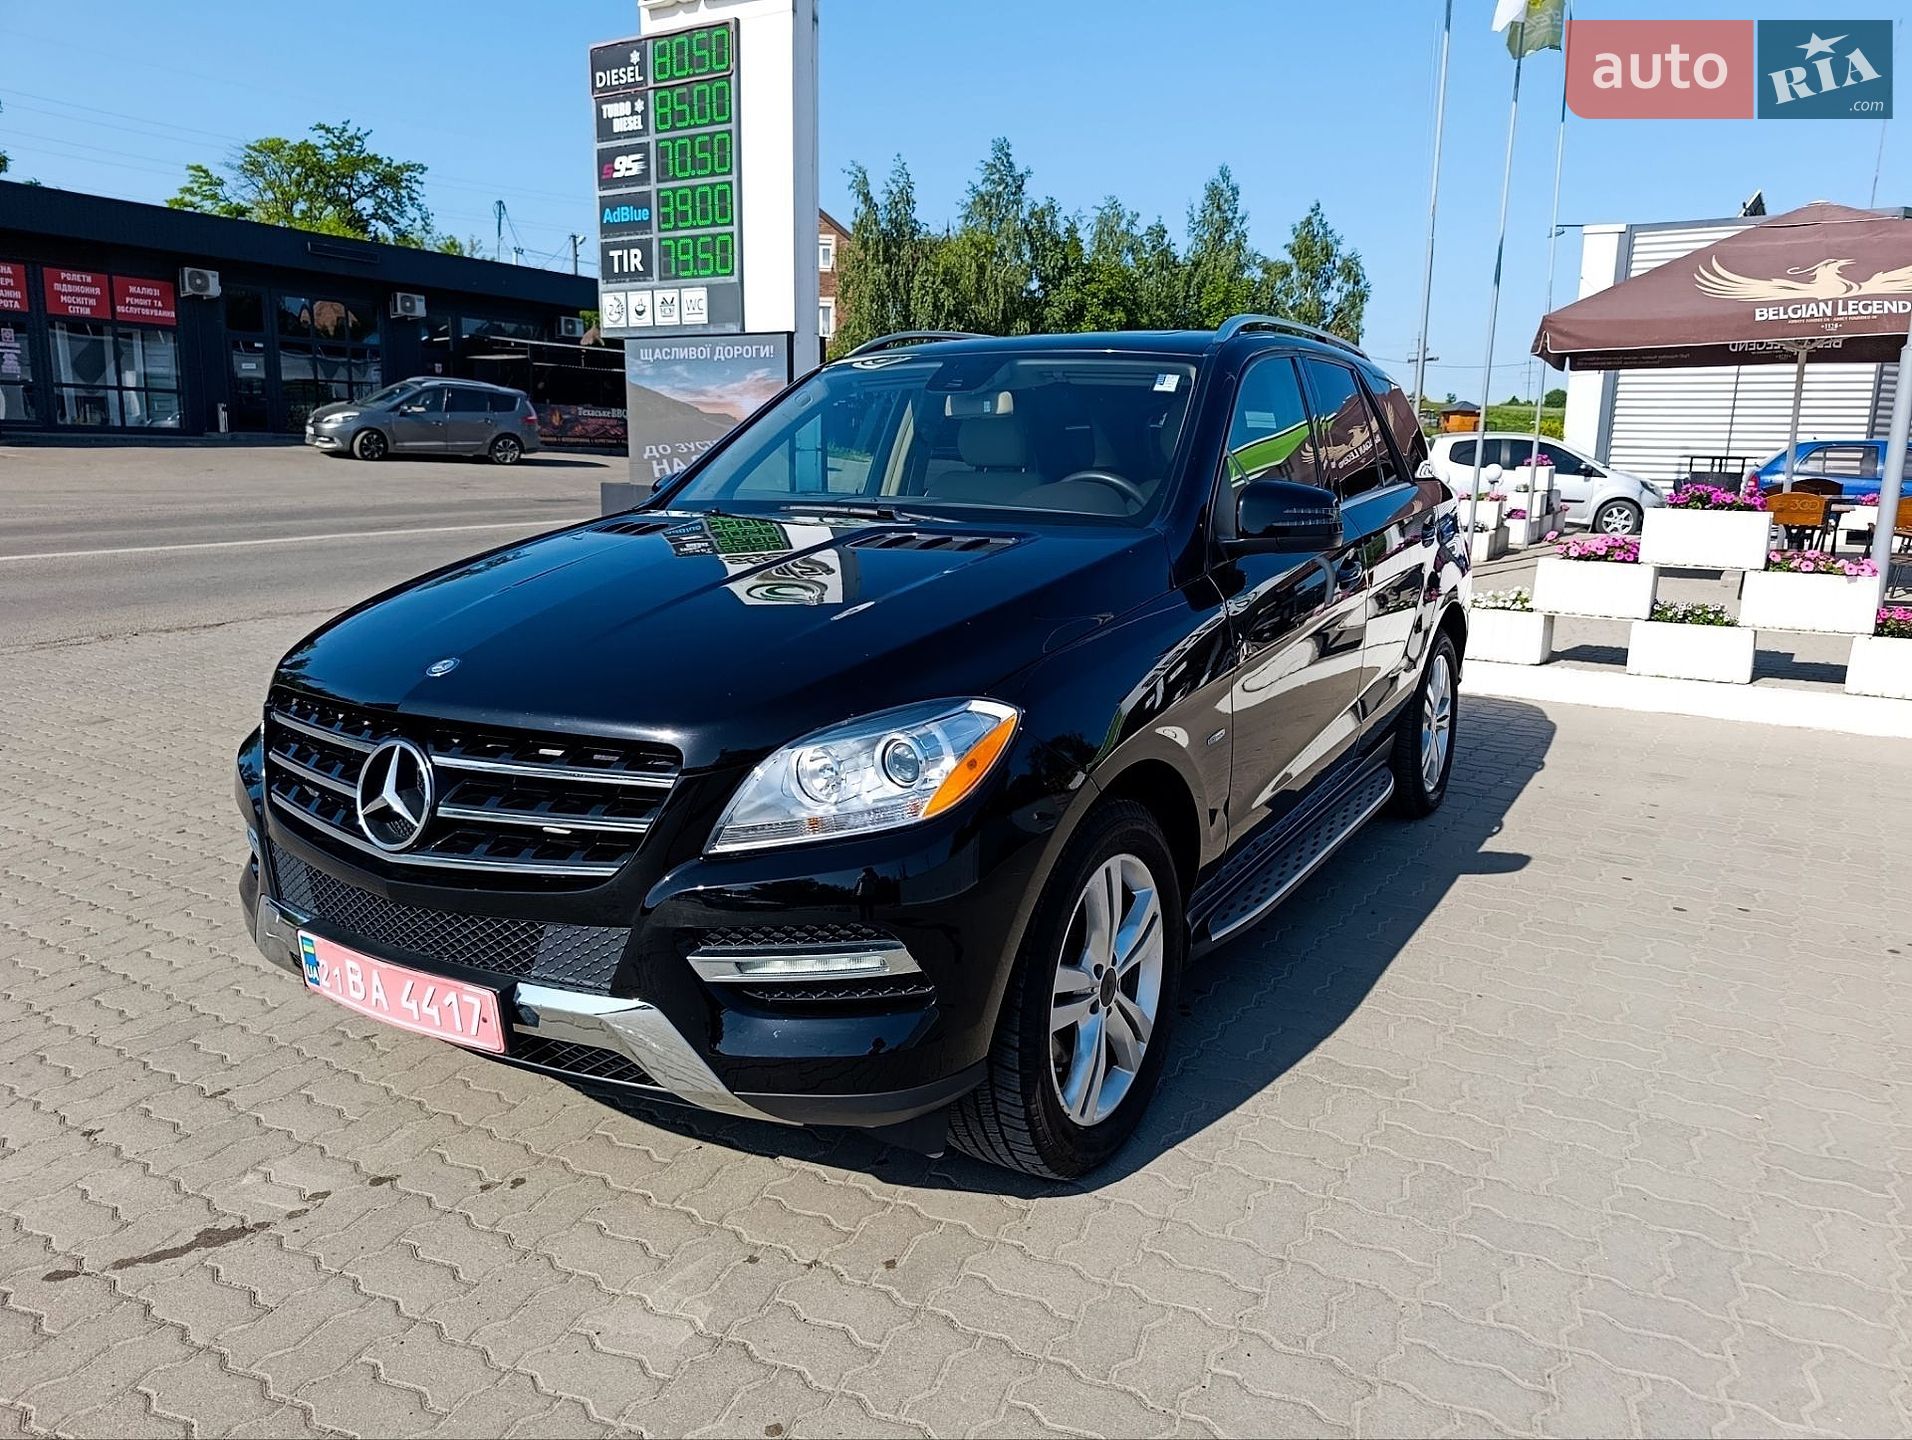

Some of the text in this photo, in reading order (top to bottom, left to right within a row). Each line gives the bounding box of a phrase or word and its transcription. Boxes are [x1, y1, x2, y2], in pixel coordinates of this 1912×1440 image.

[655, 27, 729, 81] 80.50
[596, 65, 643, 88] DIESEL
[656, 81, 730, 131] 85.00
[612, 115, 643, 133] DIESEL
[659, 132, 731, 178] 70.50
[603, 206, 650, 224] AdBlue
[659, 183, 732, 230] 39.00
[609, 248, 644, 274] TIR
[661, 234, 733, 278] 79.50
[60, 272, 92, 283] РОЛЕТИ
[53, 282, 101, 296] ПІДВІКОННЯ
[128, 285, 160, 297] ЖАЛЮЗІ
[60, 294, 96, 306] МОСКІТНІ
[125, 296, 163, 308] РЕМОНТ ТА
[686, 298, 704, 311] WC
[68, 305, 91, 316] СІТКИ
[116, 305, 176, 319] ОБСЛУГОВУВАННЯ
[609, 303, 622, 316] 24
[1755, 301, 1832, 321] BELGIAN
[1837, 299, 1912, 317] LEGEND
[640, 343, 774, 362] ЩАСЛИВОЇ ДОРОГИ!
[643, 445, 671, 459] ДО
[306, 963, 320, 981] UA
[401, 980, 482, 1036] 4417
